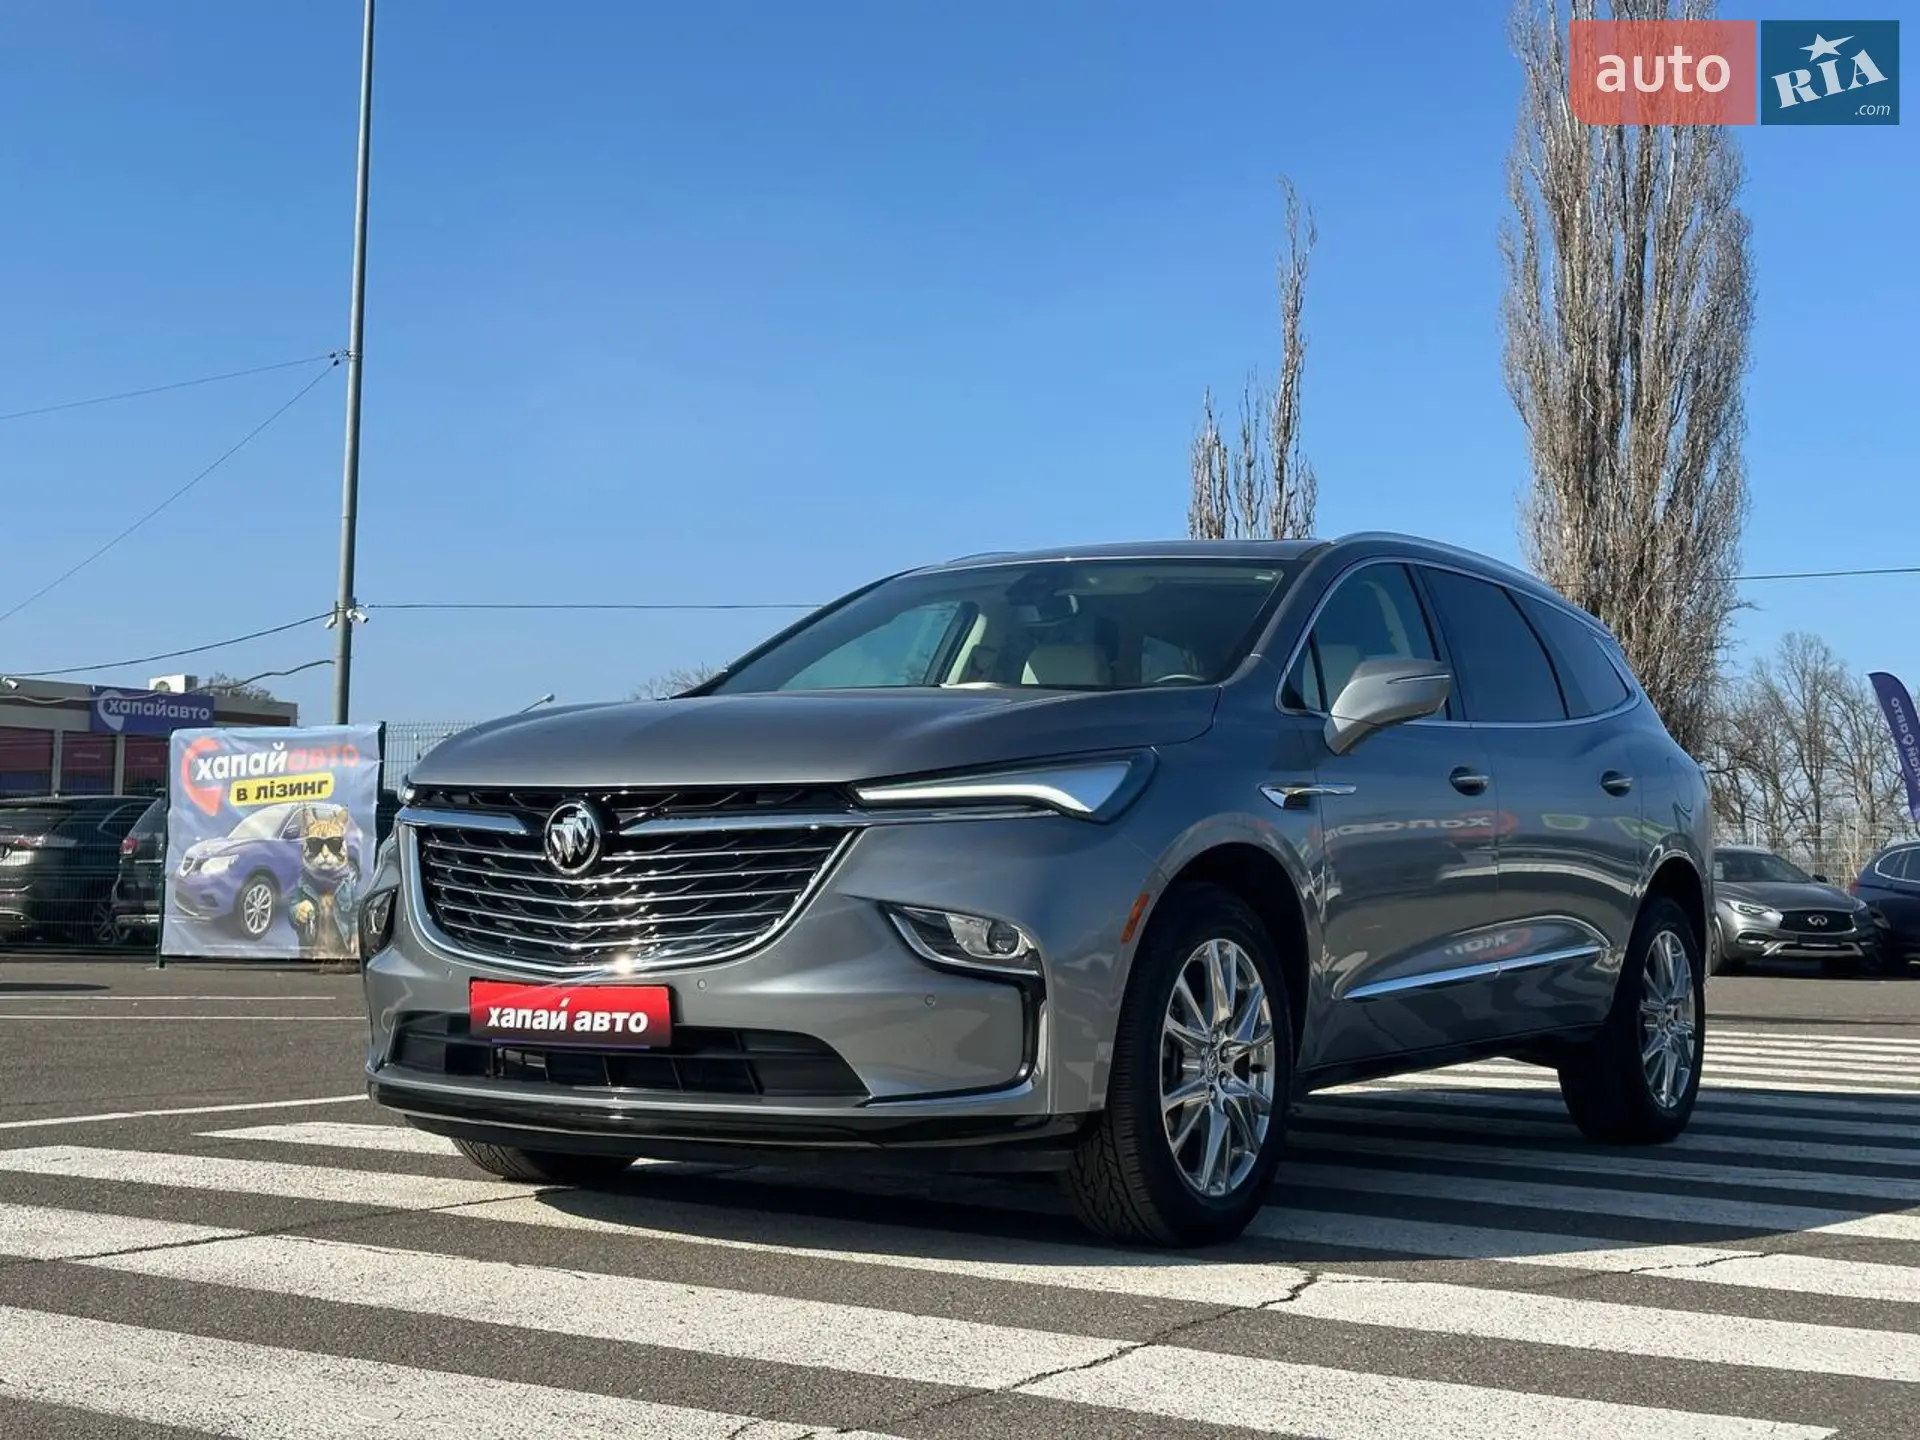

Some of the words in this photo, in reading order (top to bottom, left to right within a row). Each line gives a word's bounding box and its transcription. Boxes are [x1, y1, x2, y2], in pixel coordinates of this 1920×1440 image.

[236, 787, 248, 801] в
[255, 779, 329, 801] лізинг
[487, 998, 571, 1031] хапай
[573, 1011, 649, 1033] авто
